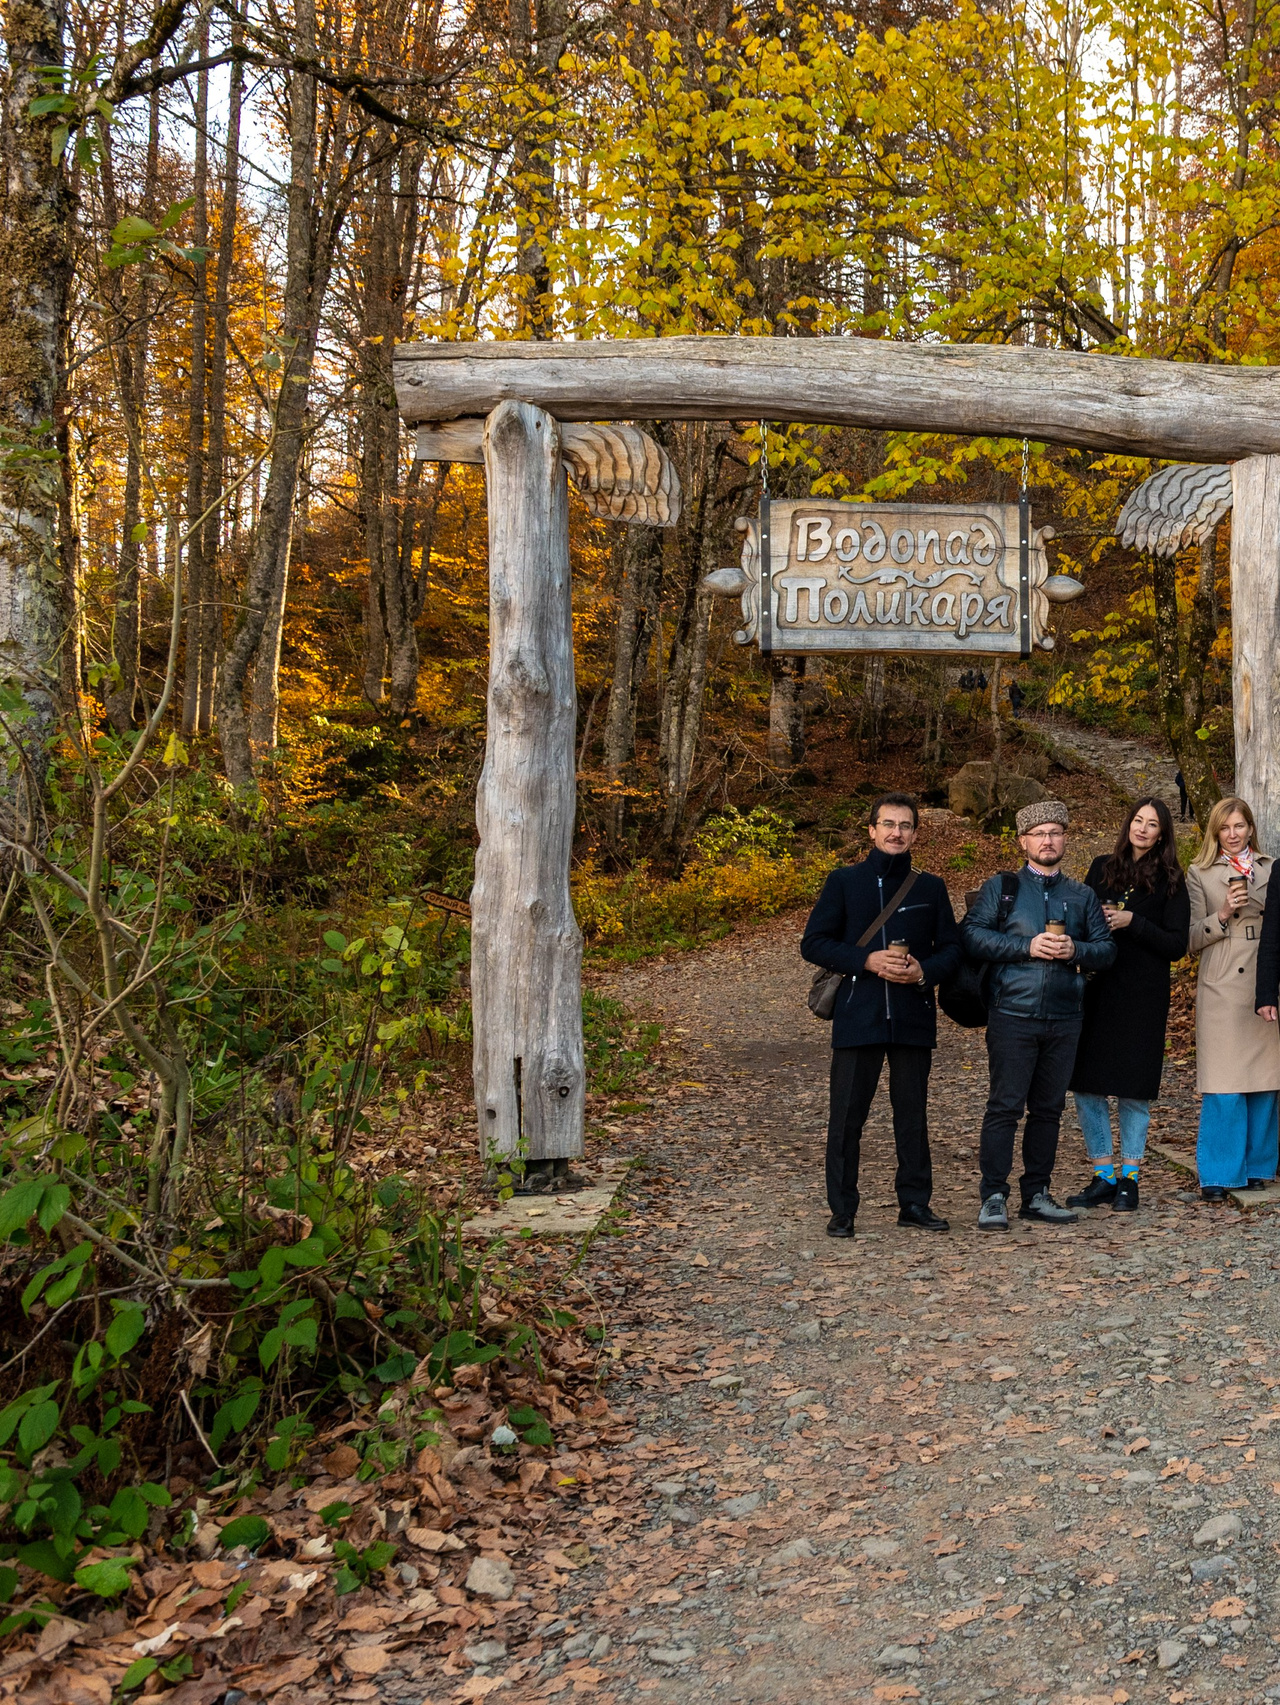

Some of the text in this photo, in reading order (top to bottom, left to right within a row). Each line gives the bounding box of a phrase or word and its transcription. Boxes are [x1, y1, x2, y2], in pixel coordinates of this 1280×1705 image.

[796, 517, 997, 566] Водопад
[780, 577, 1013, 638] Поликаря
[425, 893, 459, 909] ГОРНЫЙ
